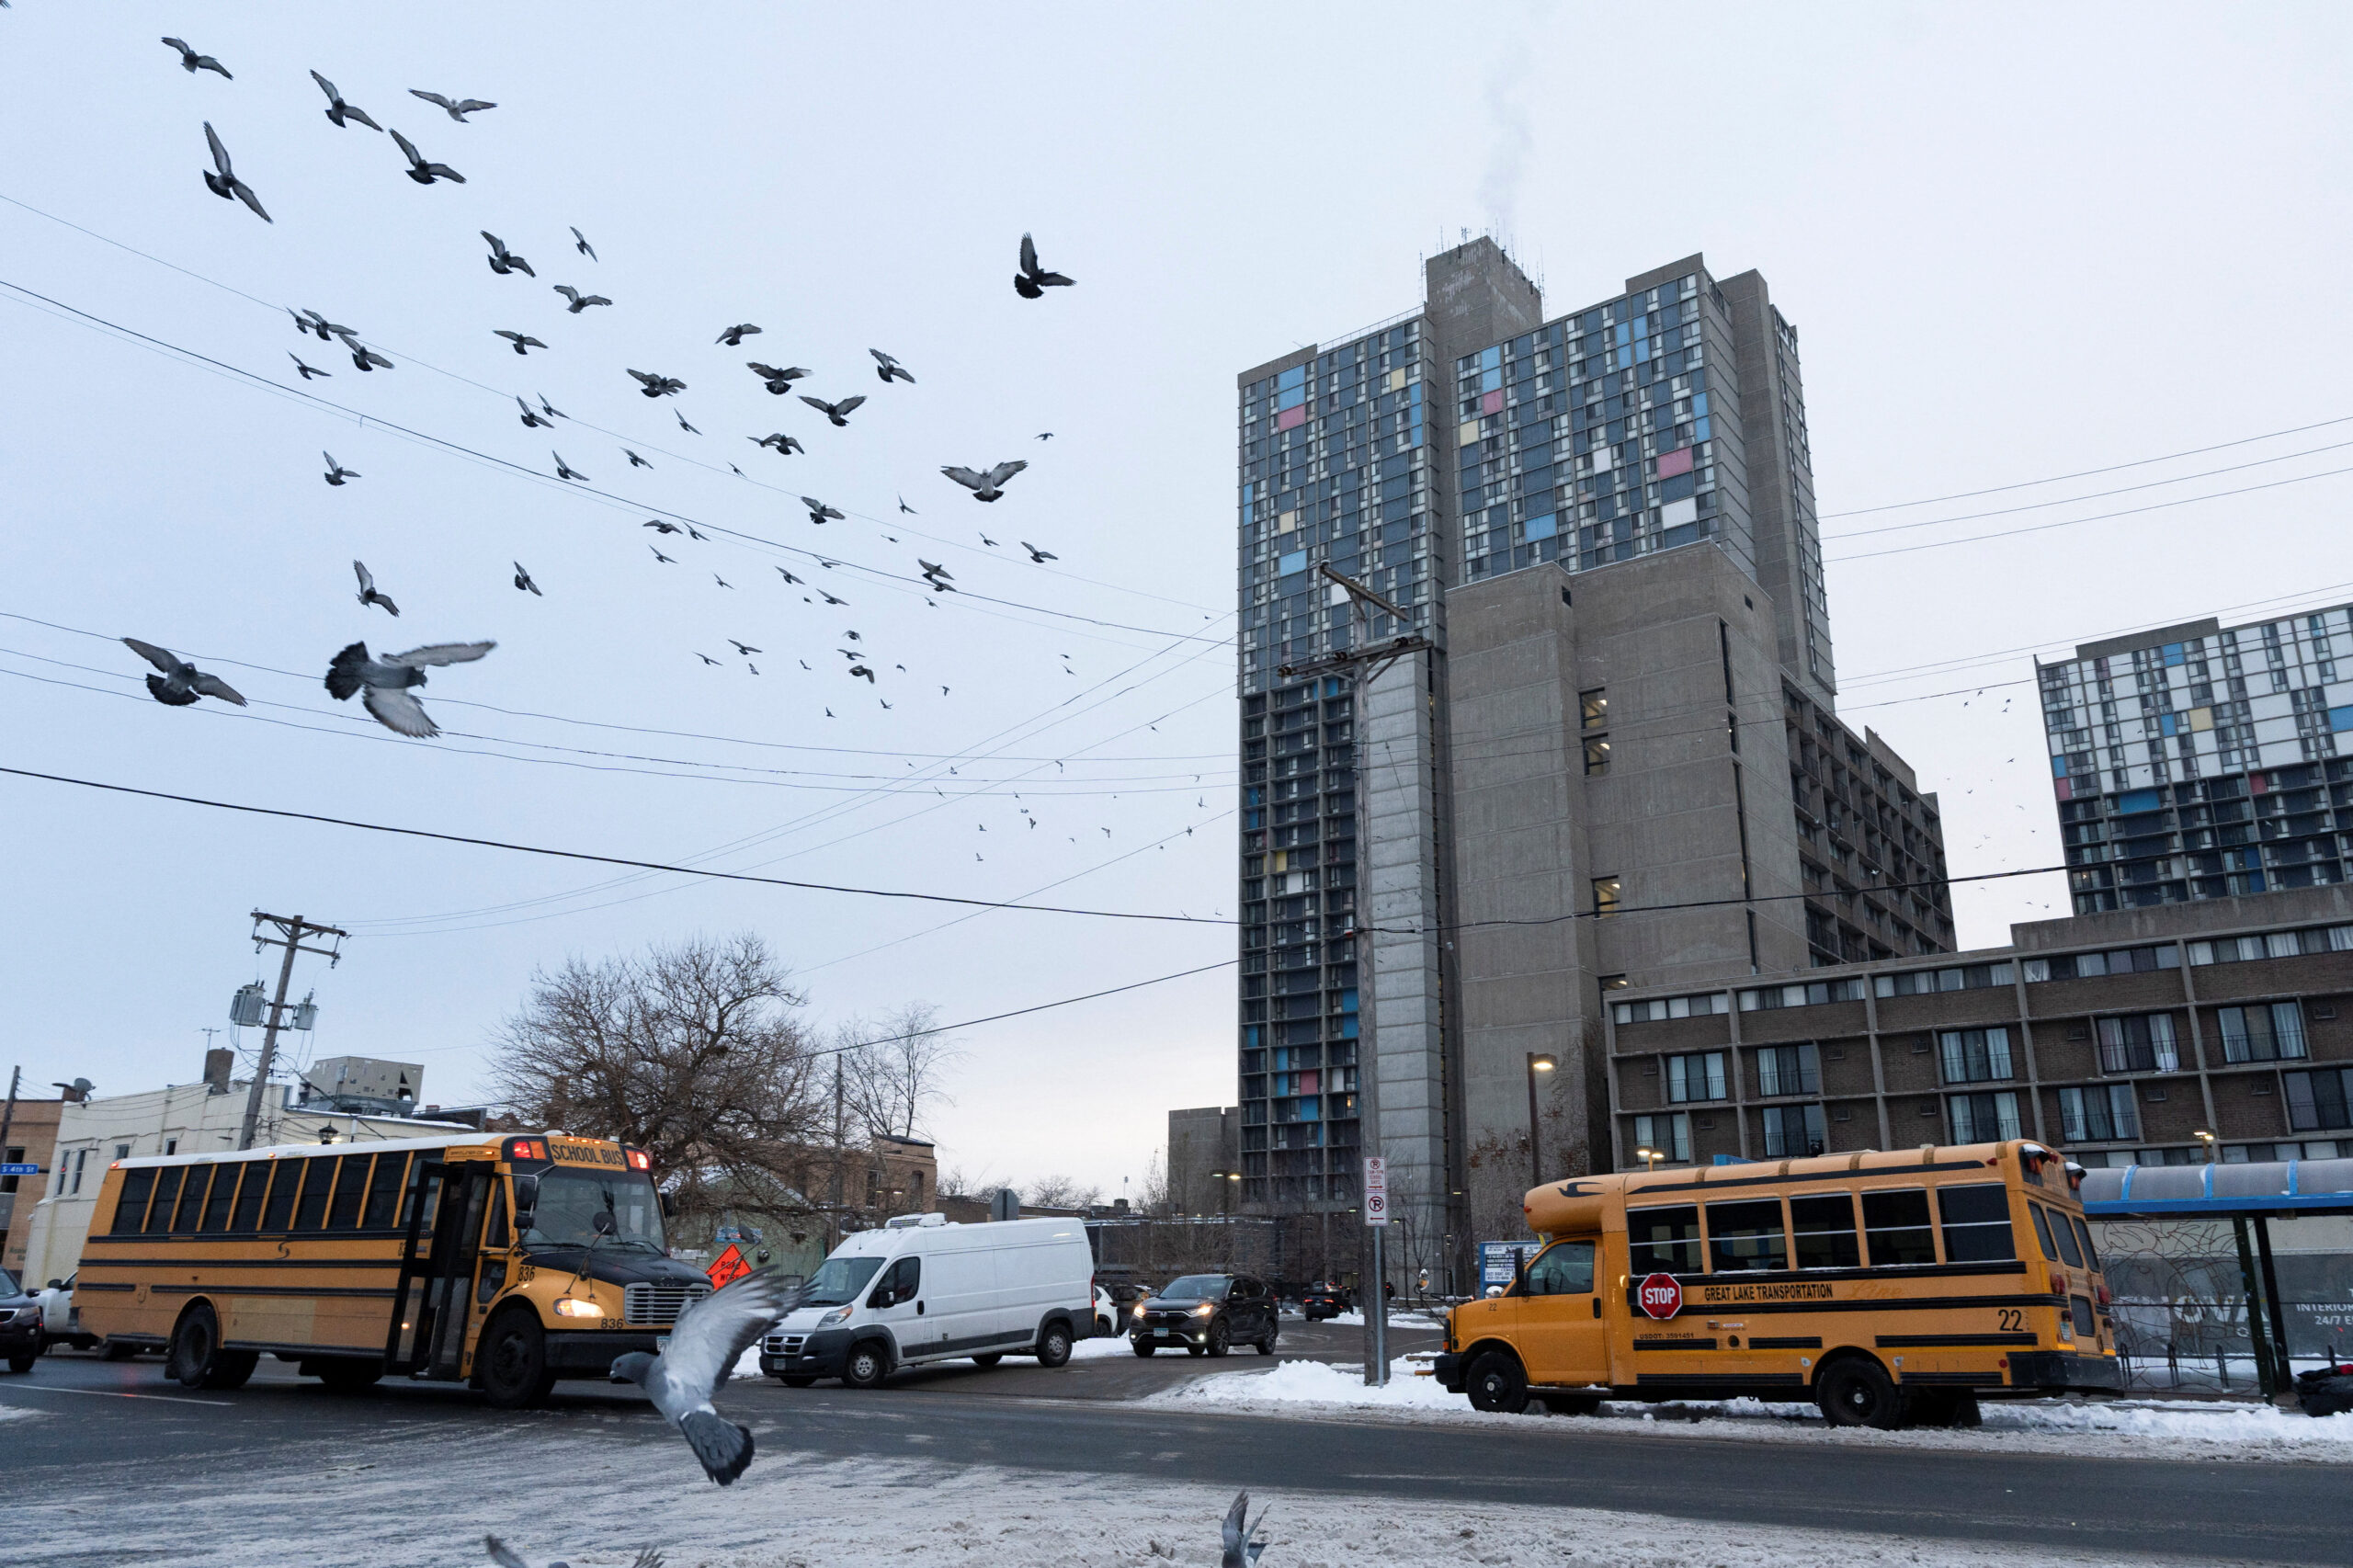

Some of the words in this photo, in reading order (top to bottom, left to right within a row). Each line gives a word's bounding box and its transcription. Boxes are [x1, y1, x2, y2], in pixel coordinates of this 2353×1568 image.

[551, 1144, 600, 1163] SCHOOL
[602, 1149, 624, 1165] BUS
[517, 1266, 536, 1281] 836
[1644, 1288, 1676, 1304] STOP
[1704, 1287, 1731, 1301] GREAT
[1733, 1286, 1755, 1301] LAKE
[1756, 1283, 1833, 1301] TRANSPORTATION
[1488, 1302, 1497, 1312] 22
[600, 1318, 624, 1329] 836
[1998, 1309, 2024, 1332] 22
[2314, 1315, 2341, 1325] 24/7
